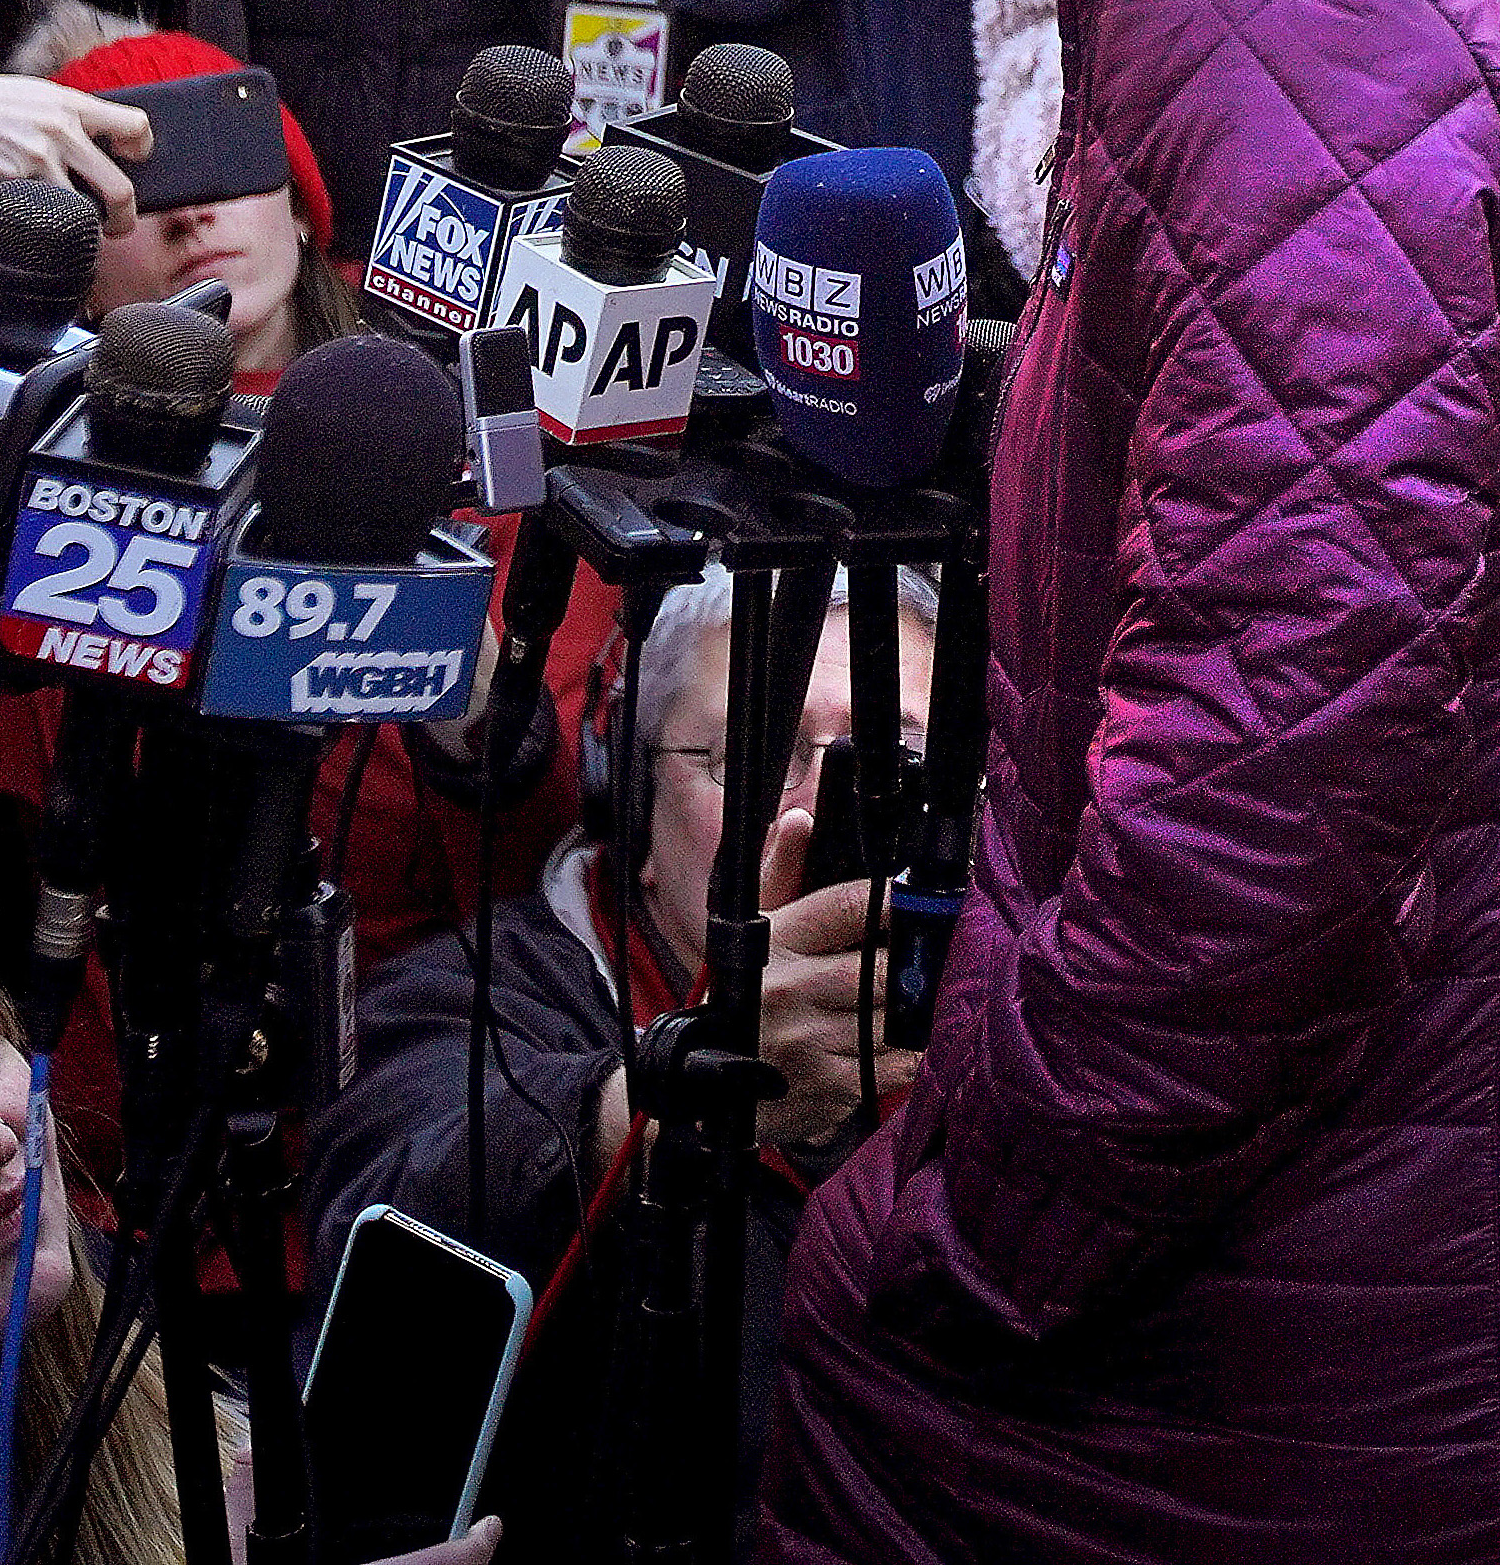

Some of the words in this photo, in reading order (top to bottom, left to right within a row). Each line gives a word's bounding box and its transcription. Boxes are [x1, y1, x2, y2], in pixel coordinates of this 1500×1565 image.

[581, 59, 645, 85] NEWS
[389, 234, 481, 302] NEWS
[416, 203, 489, 268] FOX
[373, 273, 474, 329] channel
[756, 246, 856, 312] WBZ
[505, 283, 588, 378] AP
[589, 316, 698, 397] AP
[782, 332, 855, 375] 1030
[27, 478, 208, 540] BOSTON
[11, 522, 198, 636] 25
[231, 576, 400, 642] 89.7
[36, 627, 184, 684] NEWS
[298, 656, 459, 707] WGBH
